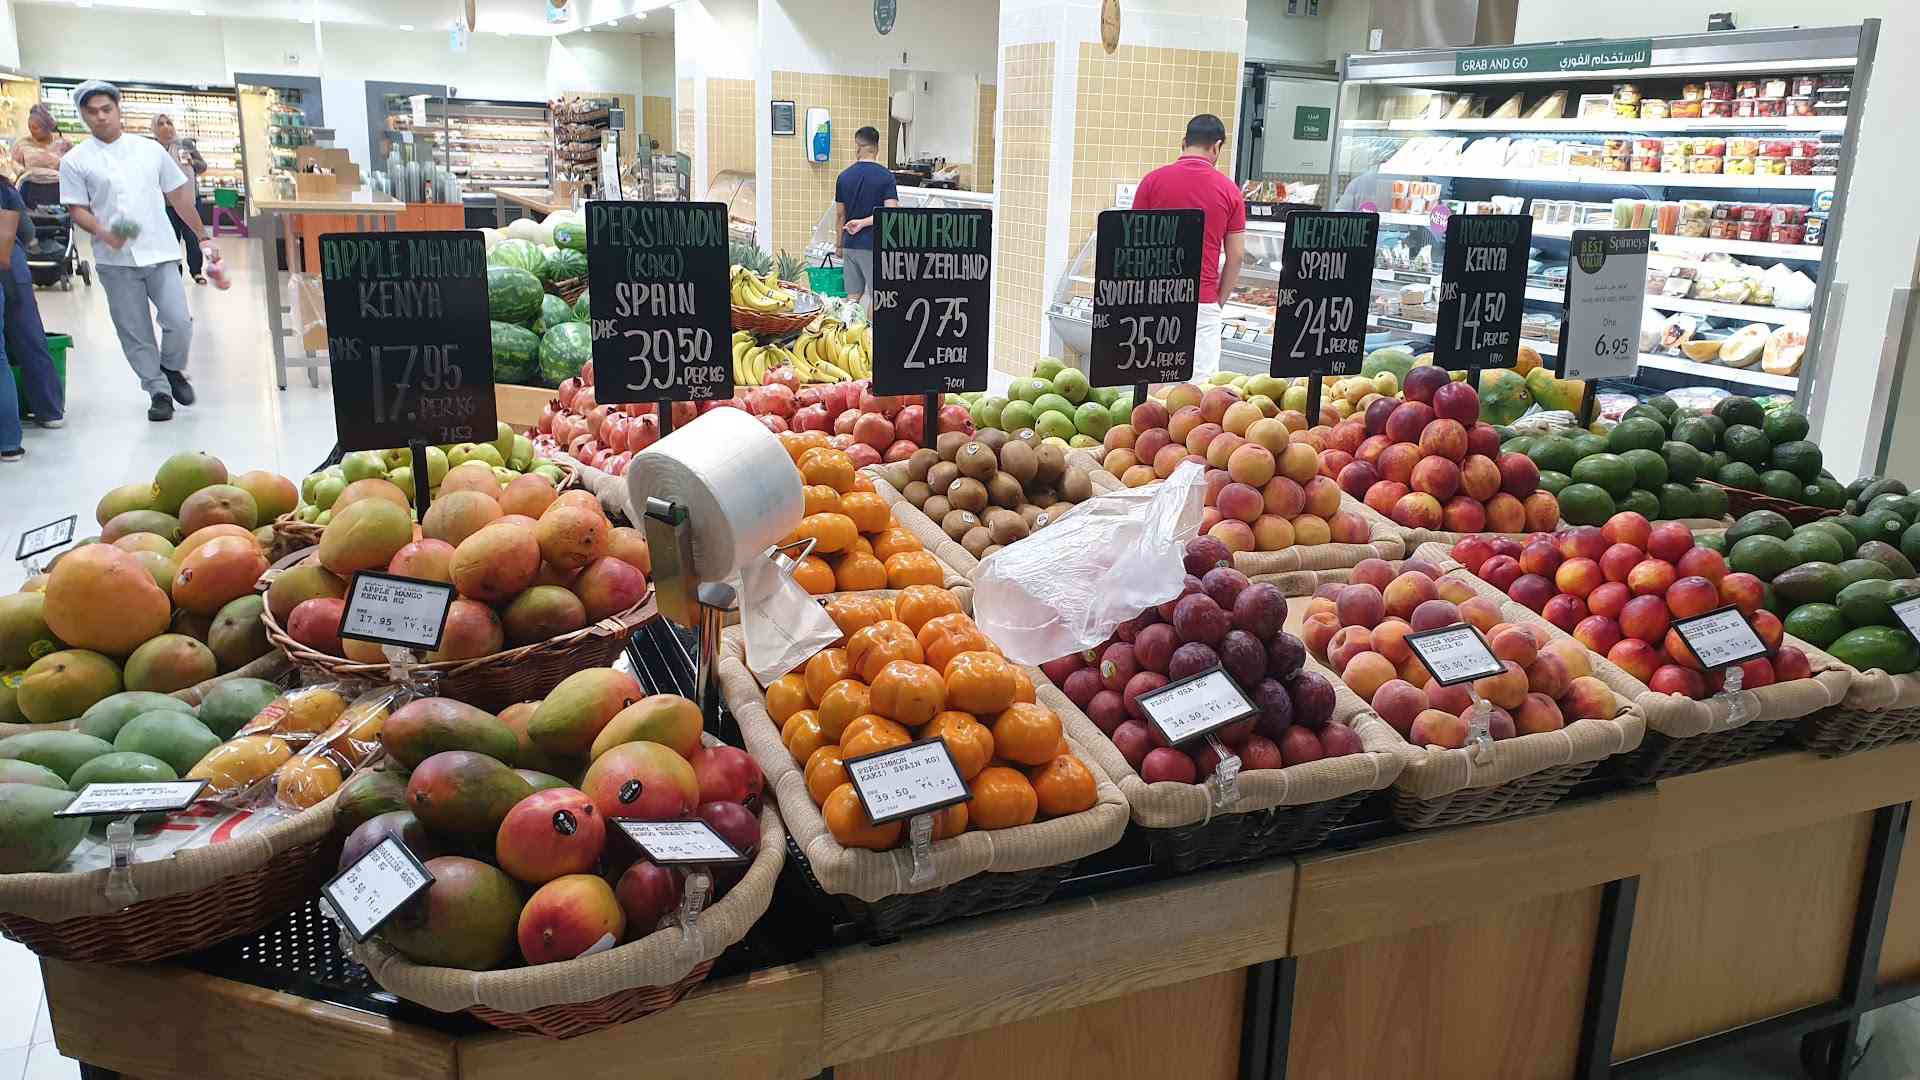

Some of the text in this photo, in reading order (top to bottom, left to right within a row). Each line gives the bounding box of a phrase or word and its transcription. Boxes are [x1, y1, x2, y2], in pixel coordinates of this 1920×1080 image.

[1462, 57, 1528, 71] GRAB AND GO
[881, 212, 982, 249] KIWI FRUIT
[1121, 213, 1180, 247] YELLOW
[1292, 216, 1370, 249] NECTARINE
[1609, 235, 1648, 251] Spinneys
[322, 239, 484, 280] APPLE MANGO
[626, 247, 684, 281] (KAKI)
[881, 251, 989, 281] NEW ZEALAND
[1113, 247, 1185, 278] PEACHES
[1297, 251, 1347, 281] SPAIN
[1464, 246, 1508, 272] KENYA
[358, 279, 443, 319] KENYA
[615, 282, 696, 317] SPAIN
[1095, 278, 1195, 306] SOUTH AFRICA
[591, 318, 618, 341] DHS
[936, 346, 968, 364] EACH
[1329, 337, 1348, 353] PER
[1594, 333, 1630, 357] 6.95
[683, 366, 725, 385] PER KG
[361, 592, 388, 602] KENYA
[362, 585, 390, 595] APPLE
[394, 590, 423, 600] MANGO
[359, 614, 392, 626] 17.95
[857, 756, 907, 775] PERSIMMON
[893, 762, 921, 774] SPAIN
[874, 786, 909, 803] 39.50
